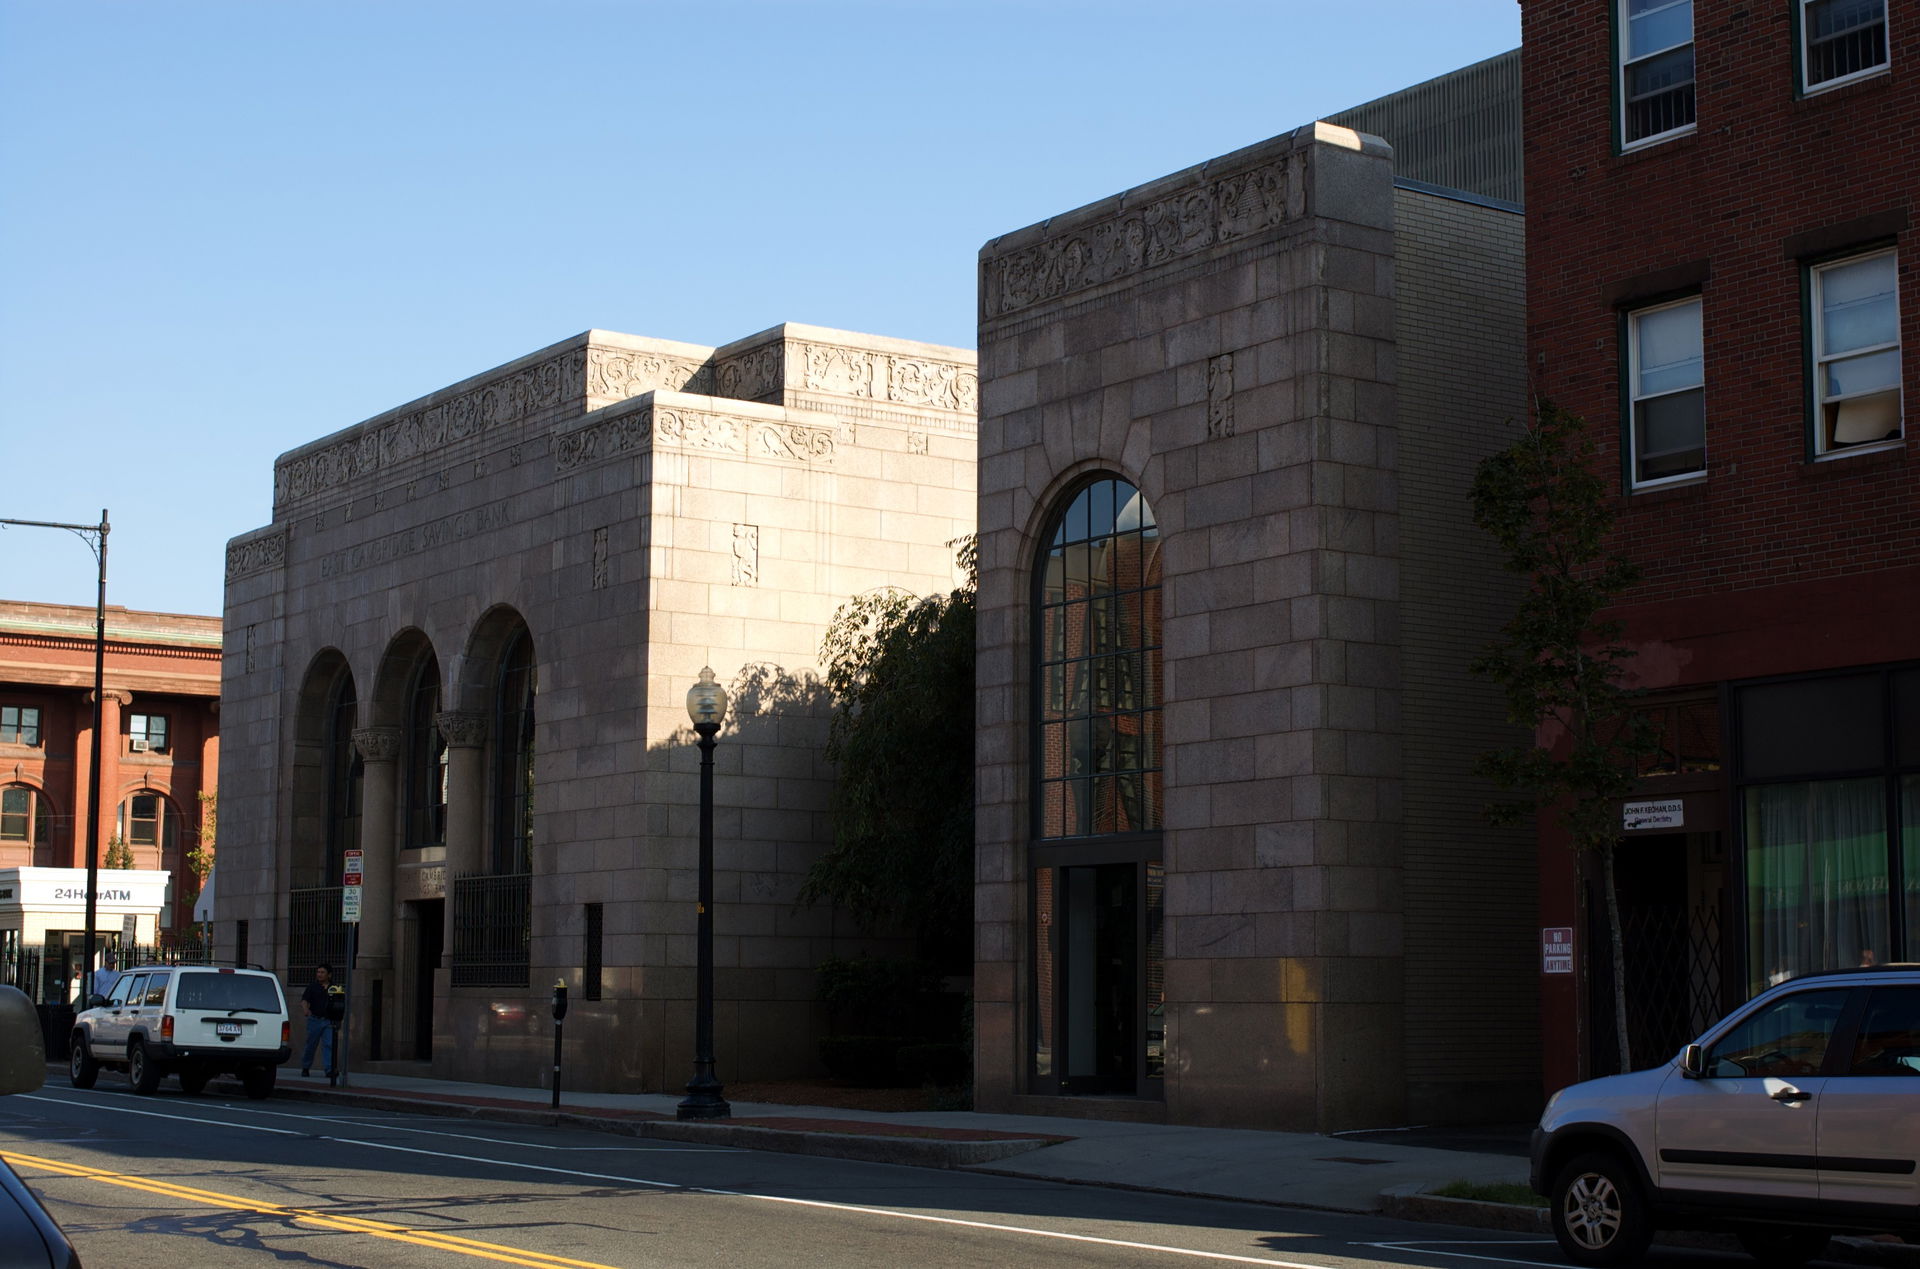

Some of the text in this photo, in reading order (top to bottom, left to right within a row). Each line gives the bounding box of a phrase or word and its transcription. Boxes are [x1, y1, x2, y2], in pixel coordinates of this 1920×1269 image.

[422, 512, 472, 548] SAVINGS
[477, 500, 511, 531] BANK
[1553, 931, 1562, 942] NO
[1544, 943, 1571, 954] PARKING
[1545, 959, 1572, 970] ANYTIME
